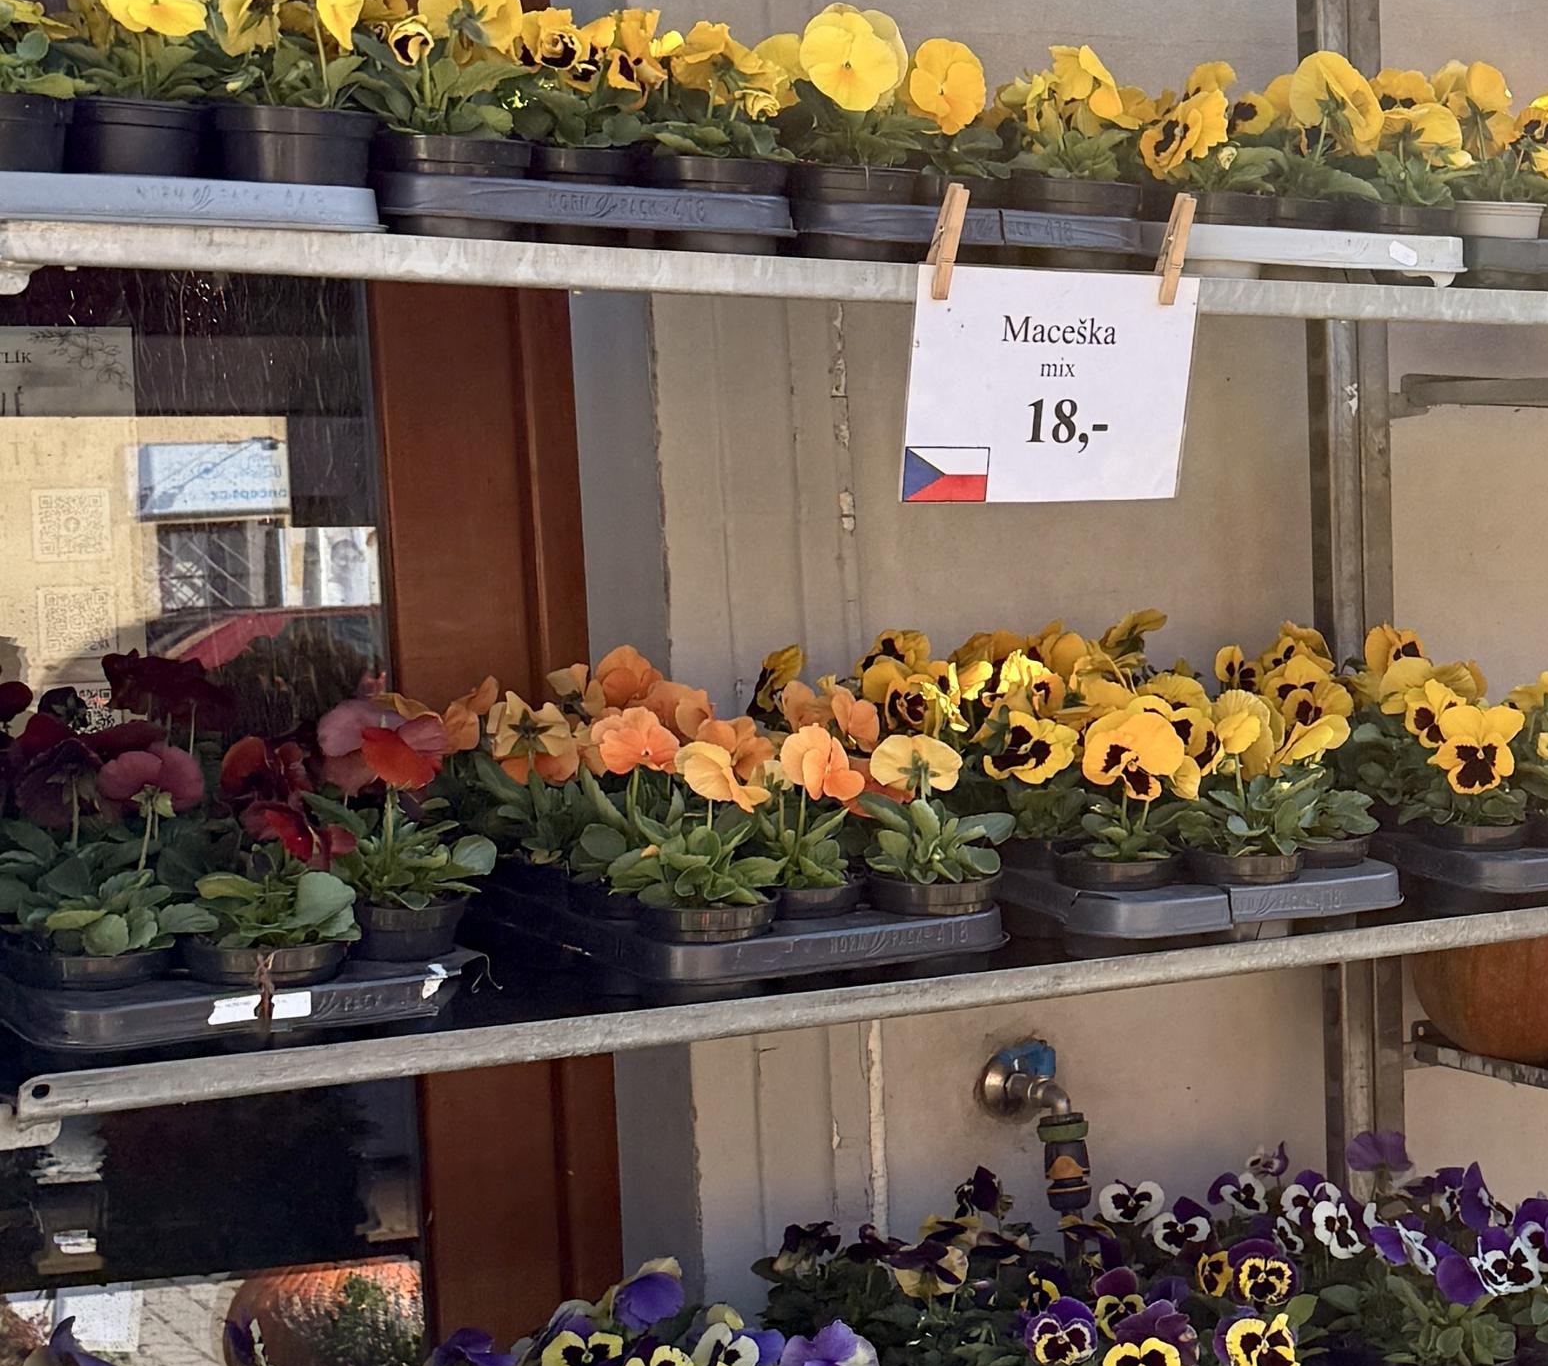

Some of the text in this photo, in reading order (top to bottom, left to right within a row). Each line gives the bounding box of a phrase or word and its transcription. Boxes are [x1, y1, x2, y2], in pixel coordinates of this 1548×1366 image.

[1001, 315, 1117, 345] Maceška
[1040, 358, 1076, 378] mix
[1026, 398, 1108, 453] 18,-
